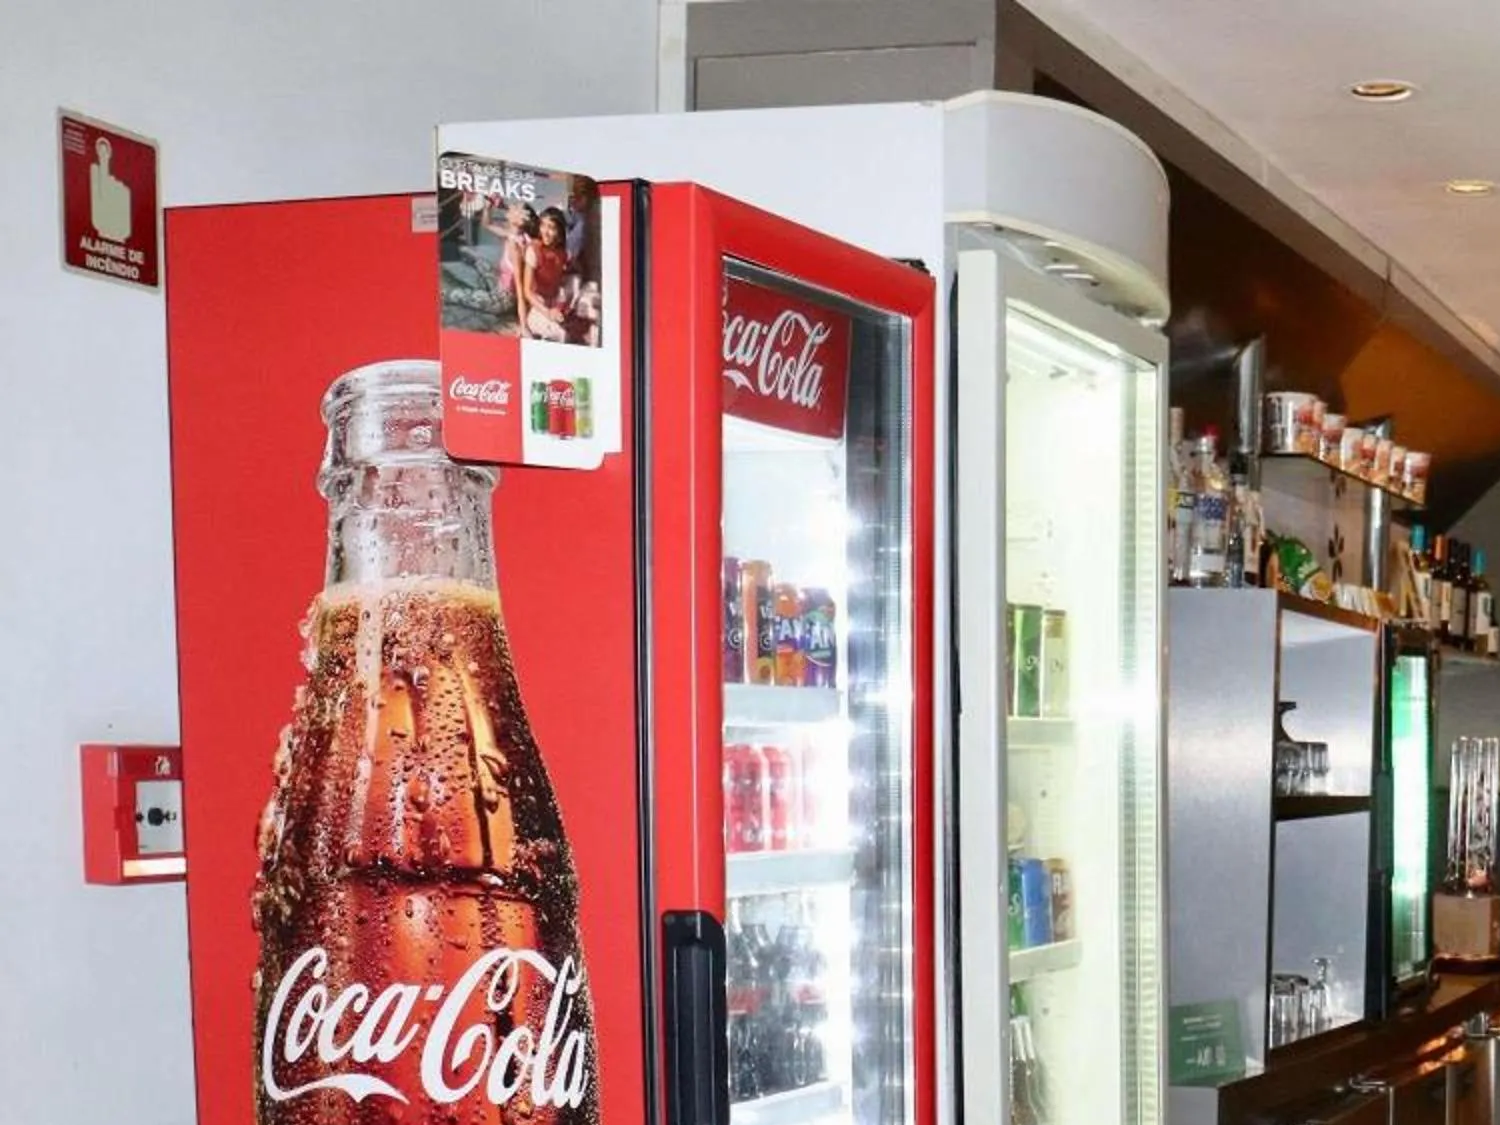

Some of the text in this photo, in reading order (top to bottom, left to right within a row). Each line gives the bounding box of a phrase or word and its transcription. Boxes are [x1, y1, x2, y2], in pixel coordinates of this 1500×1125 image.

[440, 169, 536, 202] BREAKS
[80, 236, 145, 263] ALARME DE
[85, 253, 140, 279] INCÊNDIO
[723, 310, 831, 408] ca-Cola
[449, 376, 512, 404] Coca-Cola
[263, 947, 588, 1109] Coca-Cola
